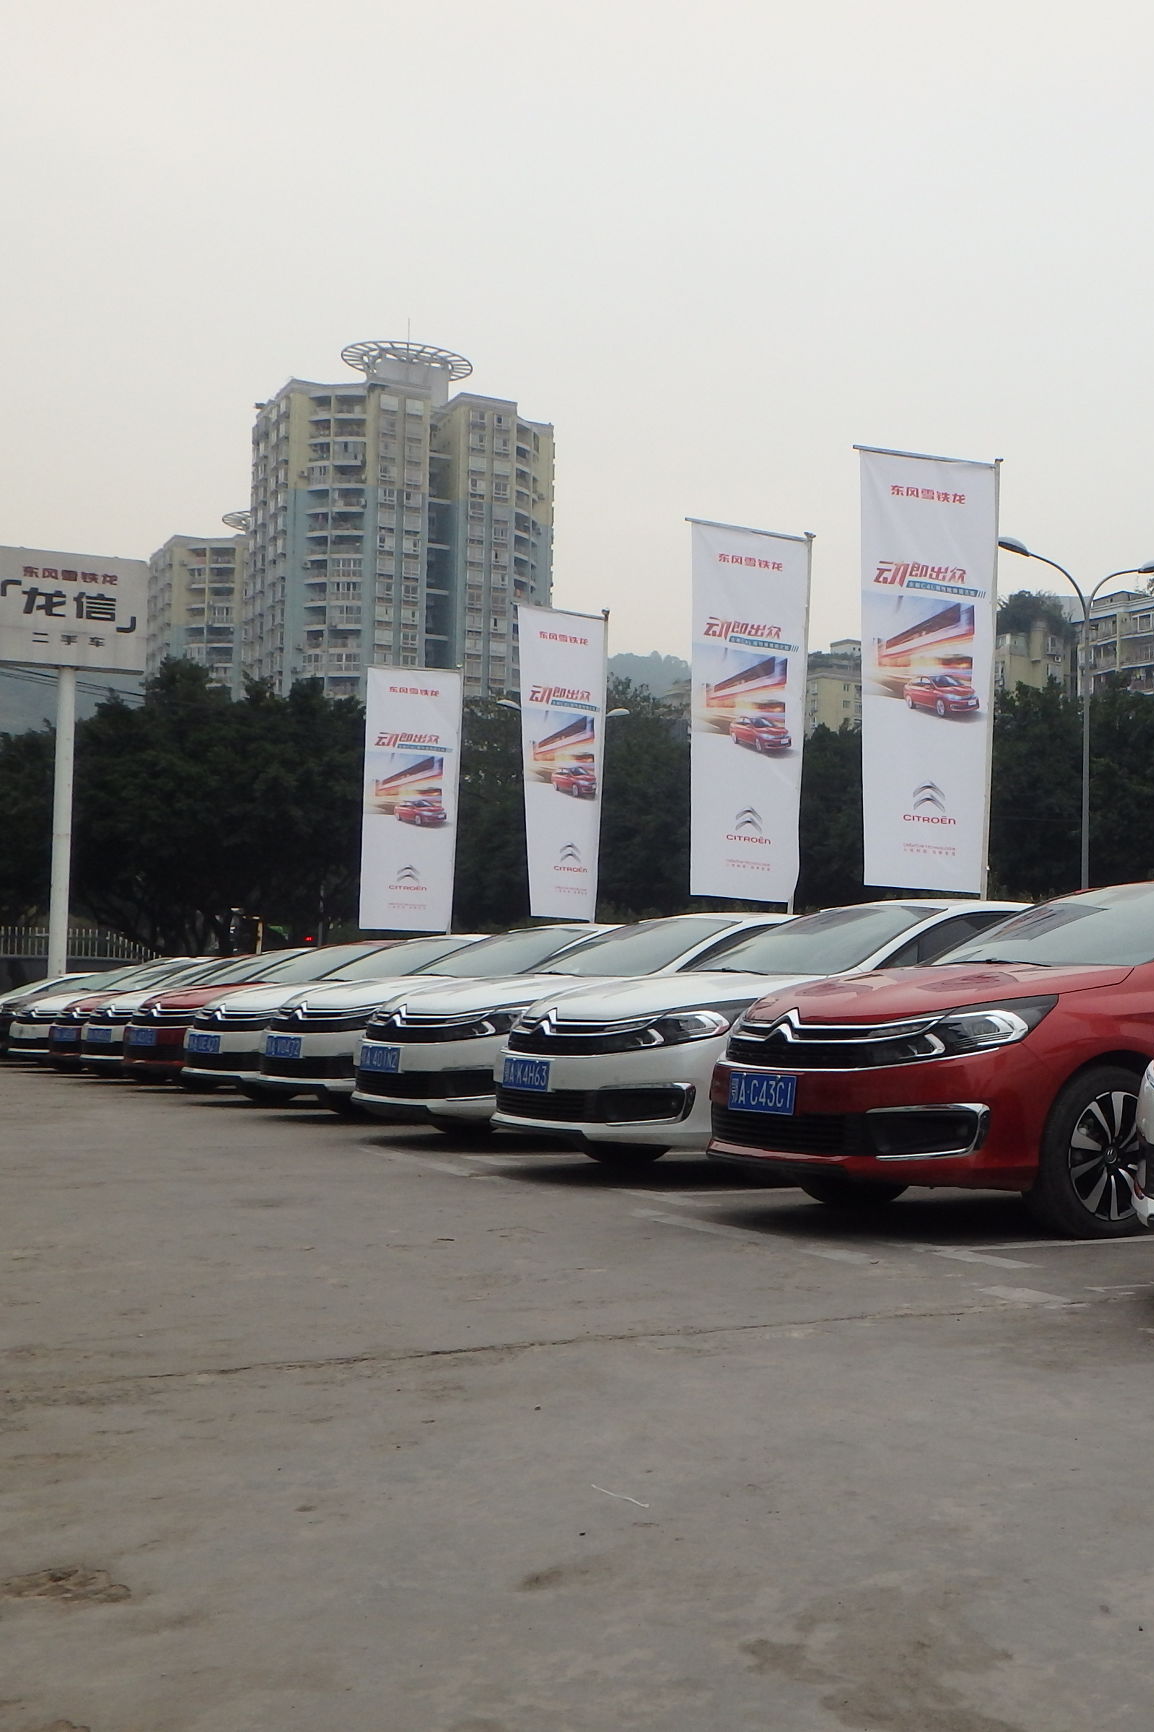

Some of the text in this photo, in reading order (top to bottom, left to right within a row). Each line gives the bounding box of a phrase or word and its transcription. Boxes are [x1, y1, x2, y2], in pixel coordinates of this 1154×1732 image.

[891, 485, 966, 504] 东风雪铁龙
[719, 553, 783, 571] 东风雪铁龙
[22, 565, 118, 585] 东风雪铁龙
[874, 561, 967, 588] 动即出众
[704, 616, 781, 641] 动即出众
[31, 632, 106, 648] 二手车
[539, 631, 588, 645] 东风雪铁龙
[389, 686, 439, 697] 东风雪铁龙
[529, 685, 591, 704] 动即出众
[374, 732, 439, 748] 动即出众
